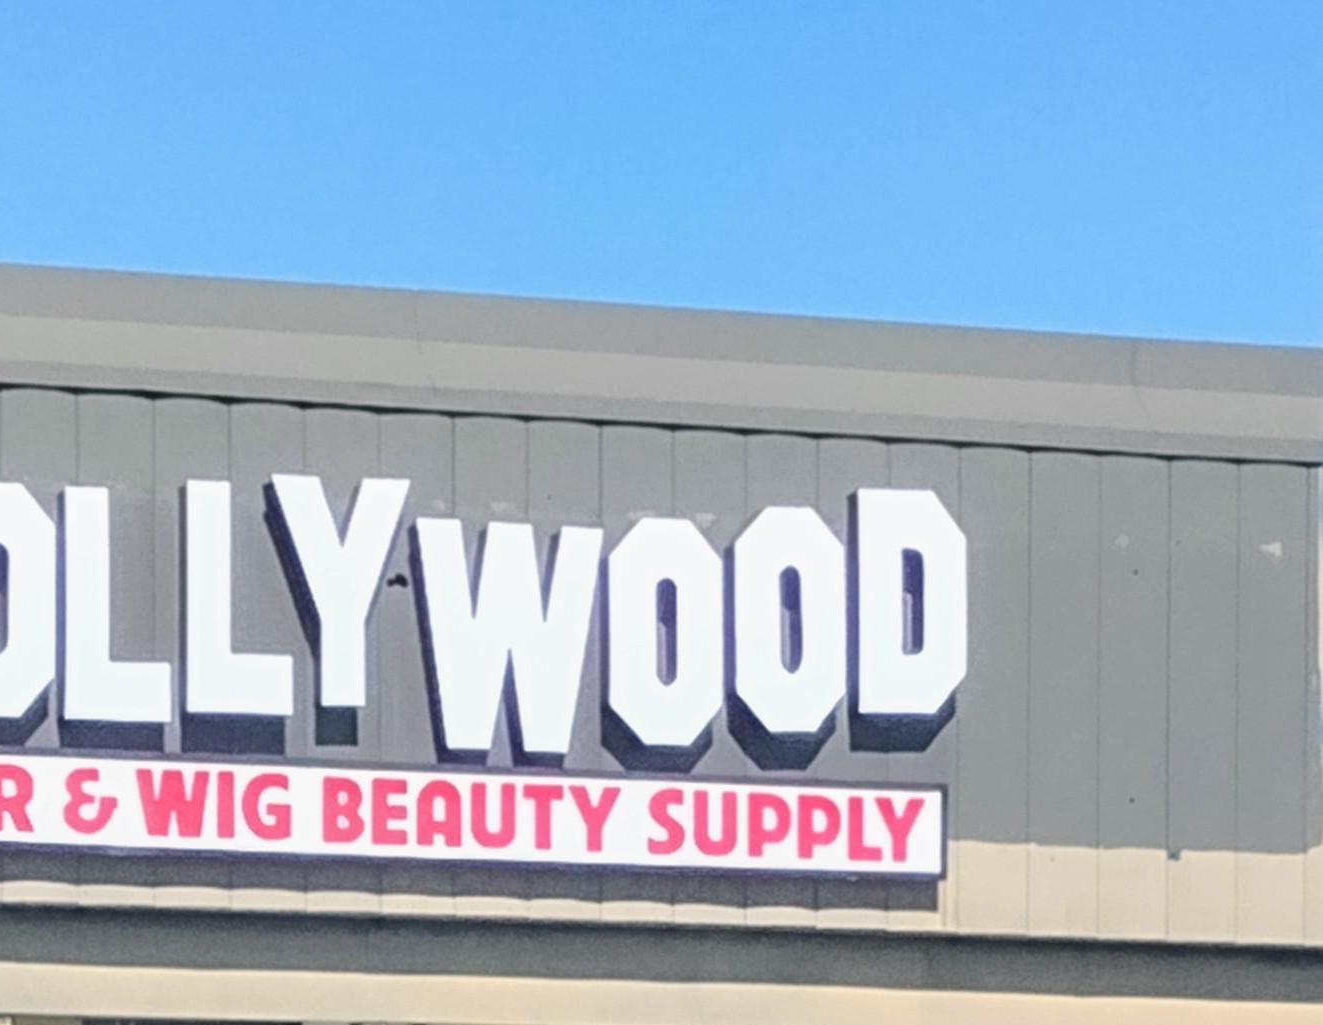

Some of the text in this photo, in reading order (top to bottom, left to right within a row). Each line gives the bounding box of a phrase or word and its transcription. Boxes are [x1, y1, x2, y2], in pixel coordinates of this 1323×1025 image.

[63, 768, 118, 834] &
[135, 768, 293, 842] WIG
[321, 776, 621, 854] BEAUTY
[647, 788, 925, 863] SUPPLY
